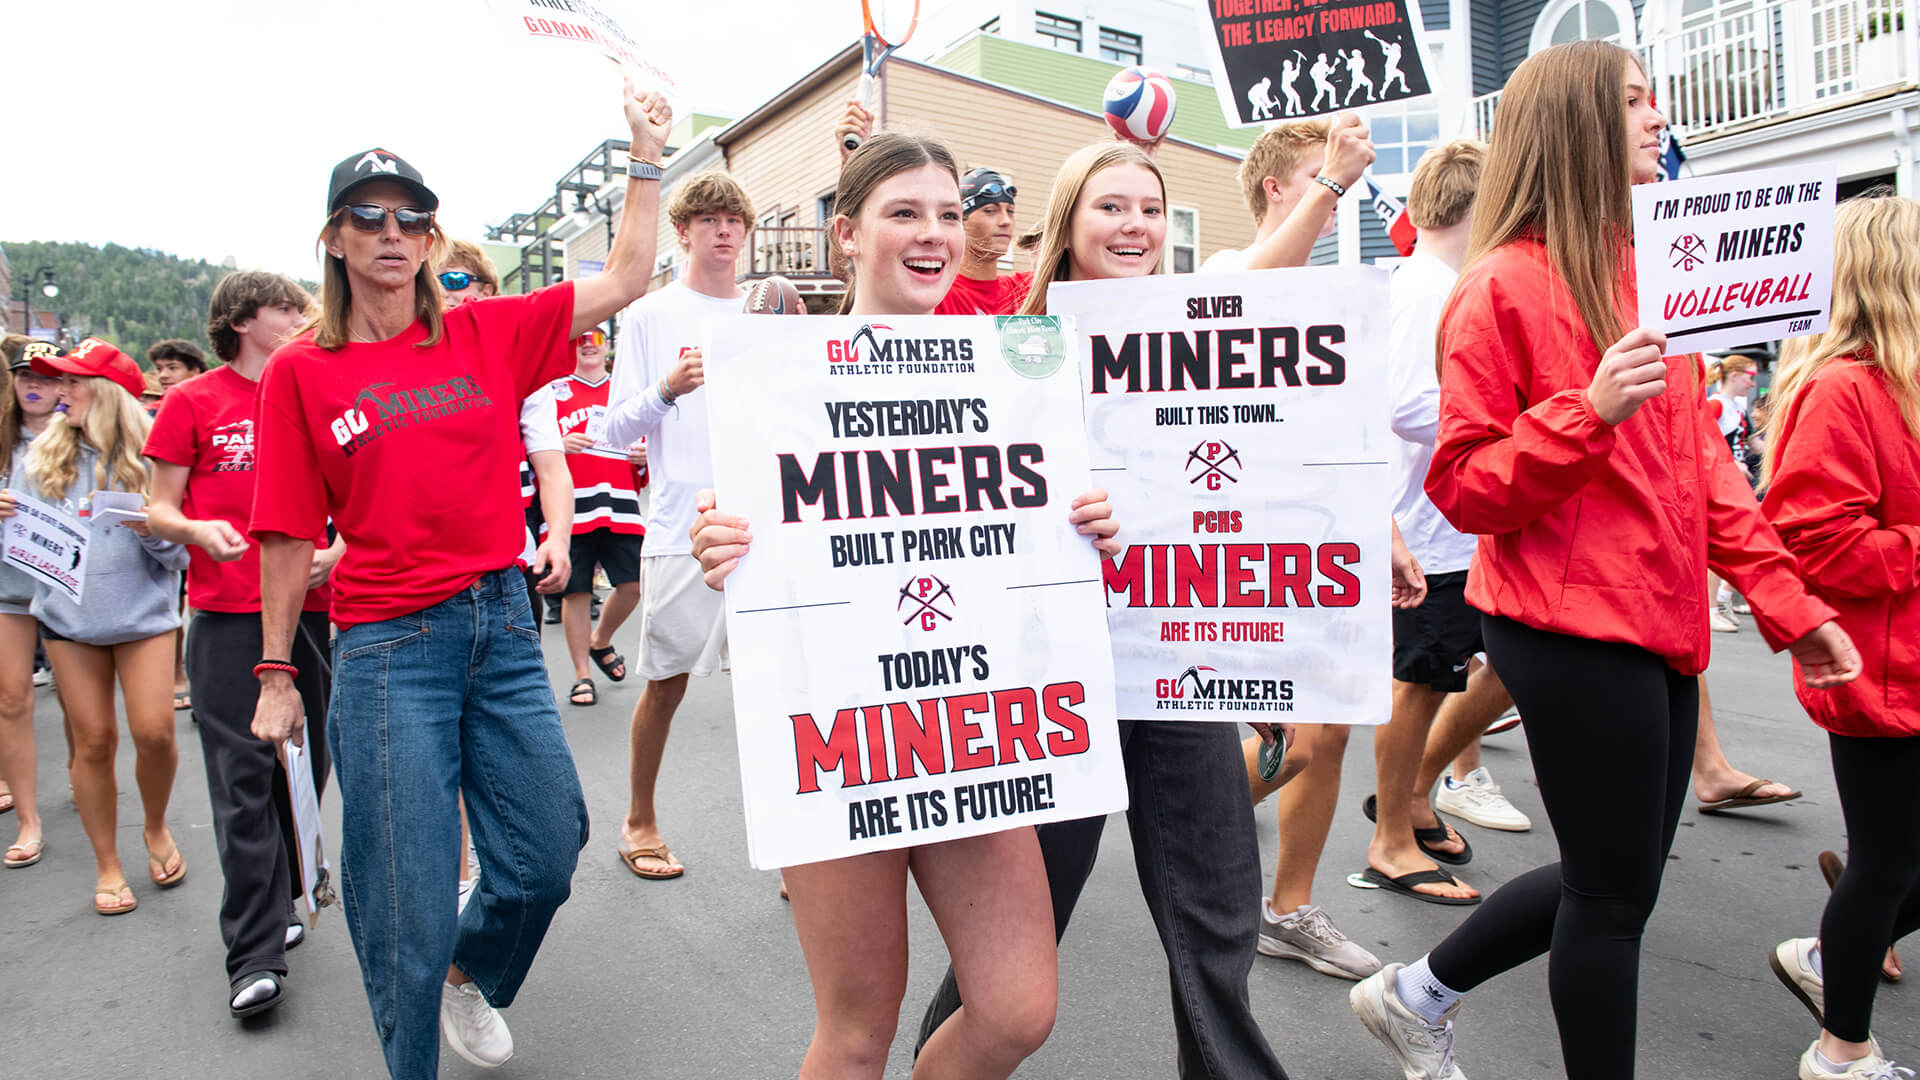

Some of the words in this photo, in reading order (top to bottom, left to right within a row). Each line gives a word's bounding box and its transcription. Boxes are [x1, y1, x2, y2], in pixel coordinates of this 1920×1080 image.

[1222, 19, 1252, 48] THE
[1256, 13, 1315, 44] LEGACY
[1319, 2, 1403, 34] FORWARD.
[1653, 199, 1680, 221] I'M
[1683, 193, 1731, 217] PROUD
[1735, 190, 1752, 211] TO
[1755, 187, 1773, 208] BE
[1775, 184, 1795, 206] ON
[1799, 181, 1822, 203] THE
[1716, 222, 1805, 263] MINERS
[1186, 295, 1243, 319] SILVER
[1664, 272, 1812, 320] VOLLEYBALL
[1788, 319, 1812, 333] TEAM
[830, 364, 893, 375] ATHLETIC
[899, 363, 975, 374] FOUNDATION
[868, 338, 973, 361] MINERS
[1088, 324, 1346, 394] MINERS
[375, 374, 484, 420] MINERS
[1155, 406, 1194, 426] BUILT
[1197, 405, 1229, 425] THIS
[1233, 404, 1284, 424] TOWN..
[341, 416, 409, 458] ATHLETIC
[413, 396, 494, 424] FOUNDATION
[825, 398, 989, 438] YESTERDAY'S
[776, 442, 1049, 523] MINERS
[1193, 510, 1243, 533] PCHS
[30, 531, 64, 556] MINERS
[830, 531, 895, 568] BUILT
[902, 526, 963, 562] PARK
[970, 522, 1016, 557] CITY
[1101, 542, 1361, 608] MINERS
[1160, 622, 1190, 642] ARE
[1194, 622, 1218, 642] ITS
[1222, 622, 1284, 642] FUTURE!
[878, 644, 990, 691] TODAY'S
[1156, 701, 1214, 711] ATHLETIC
[1219, 701, 1294, 711] FOUNDATION
[1193, 679, 1294, 700] MINERS
[789, 681, 1091, 795] MINERS
[849, 796, 900, 841] ARE
[908, 790, 948, 833] ITS
[954, 773, 1056, 824] FUTURE!
